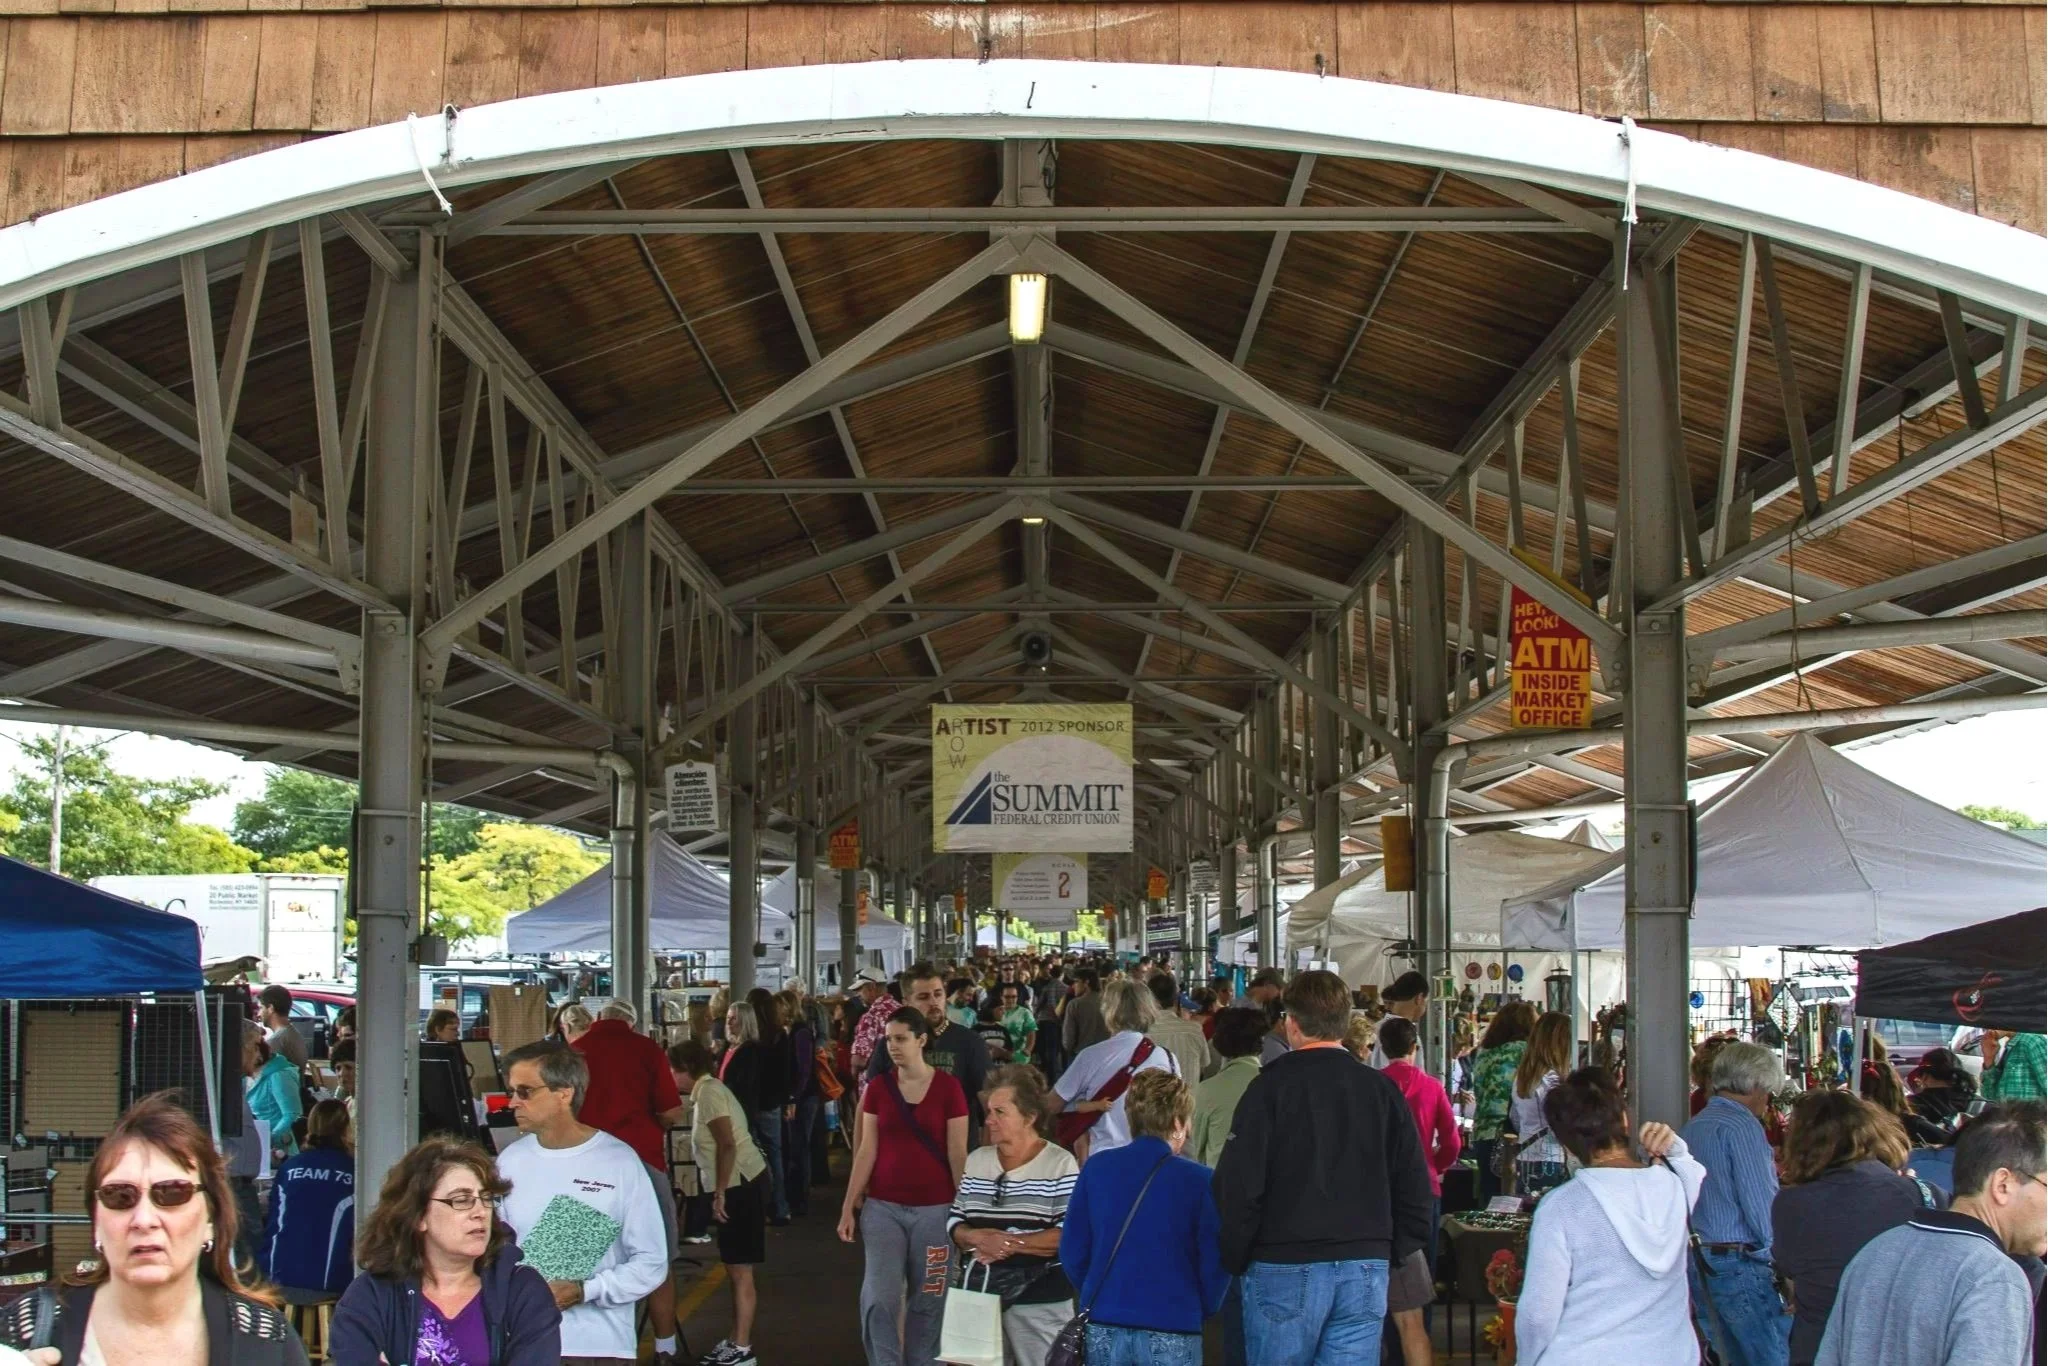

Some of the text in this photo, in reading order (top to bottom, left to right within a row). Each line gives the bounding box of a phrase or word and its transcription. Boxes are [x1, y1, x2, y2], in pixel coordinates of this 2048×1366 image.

[1514, 602, 1547, 618] HEY,
[1514, 615, 1560, 634] LOOK!
[1513, 636, 1589, 670] ATM
[1521, 673, 1581, 691] INSIDE
[1514, 691, 1588, 709] MARKET
[935, 717, 1125, 736] ARTIST 2012 SPONSOR
[1518, 709, 1582, 727] OFFICE
[993, 771, 1011, 783] the
[992, 784, 1124, 813] SUMMIT
[994, 813, 1120, 825] FEDERAL CREDIT UNION
[831, 835, 857, 847] ATM
[1058, 871, 1070, 899] 2
[287, 1167, 330, 1181] TEAM
[592, 1181, 616, 1190] Jersey
[922, 1244, 950, 1297] RIT
